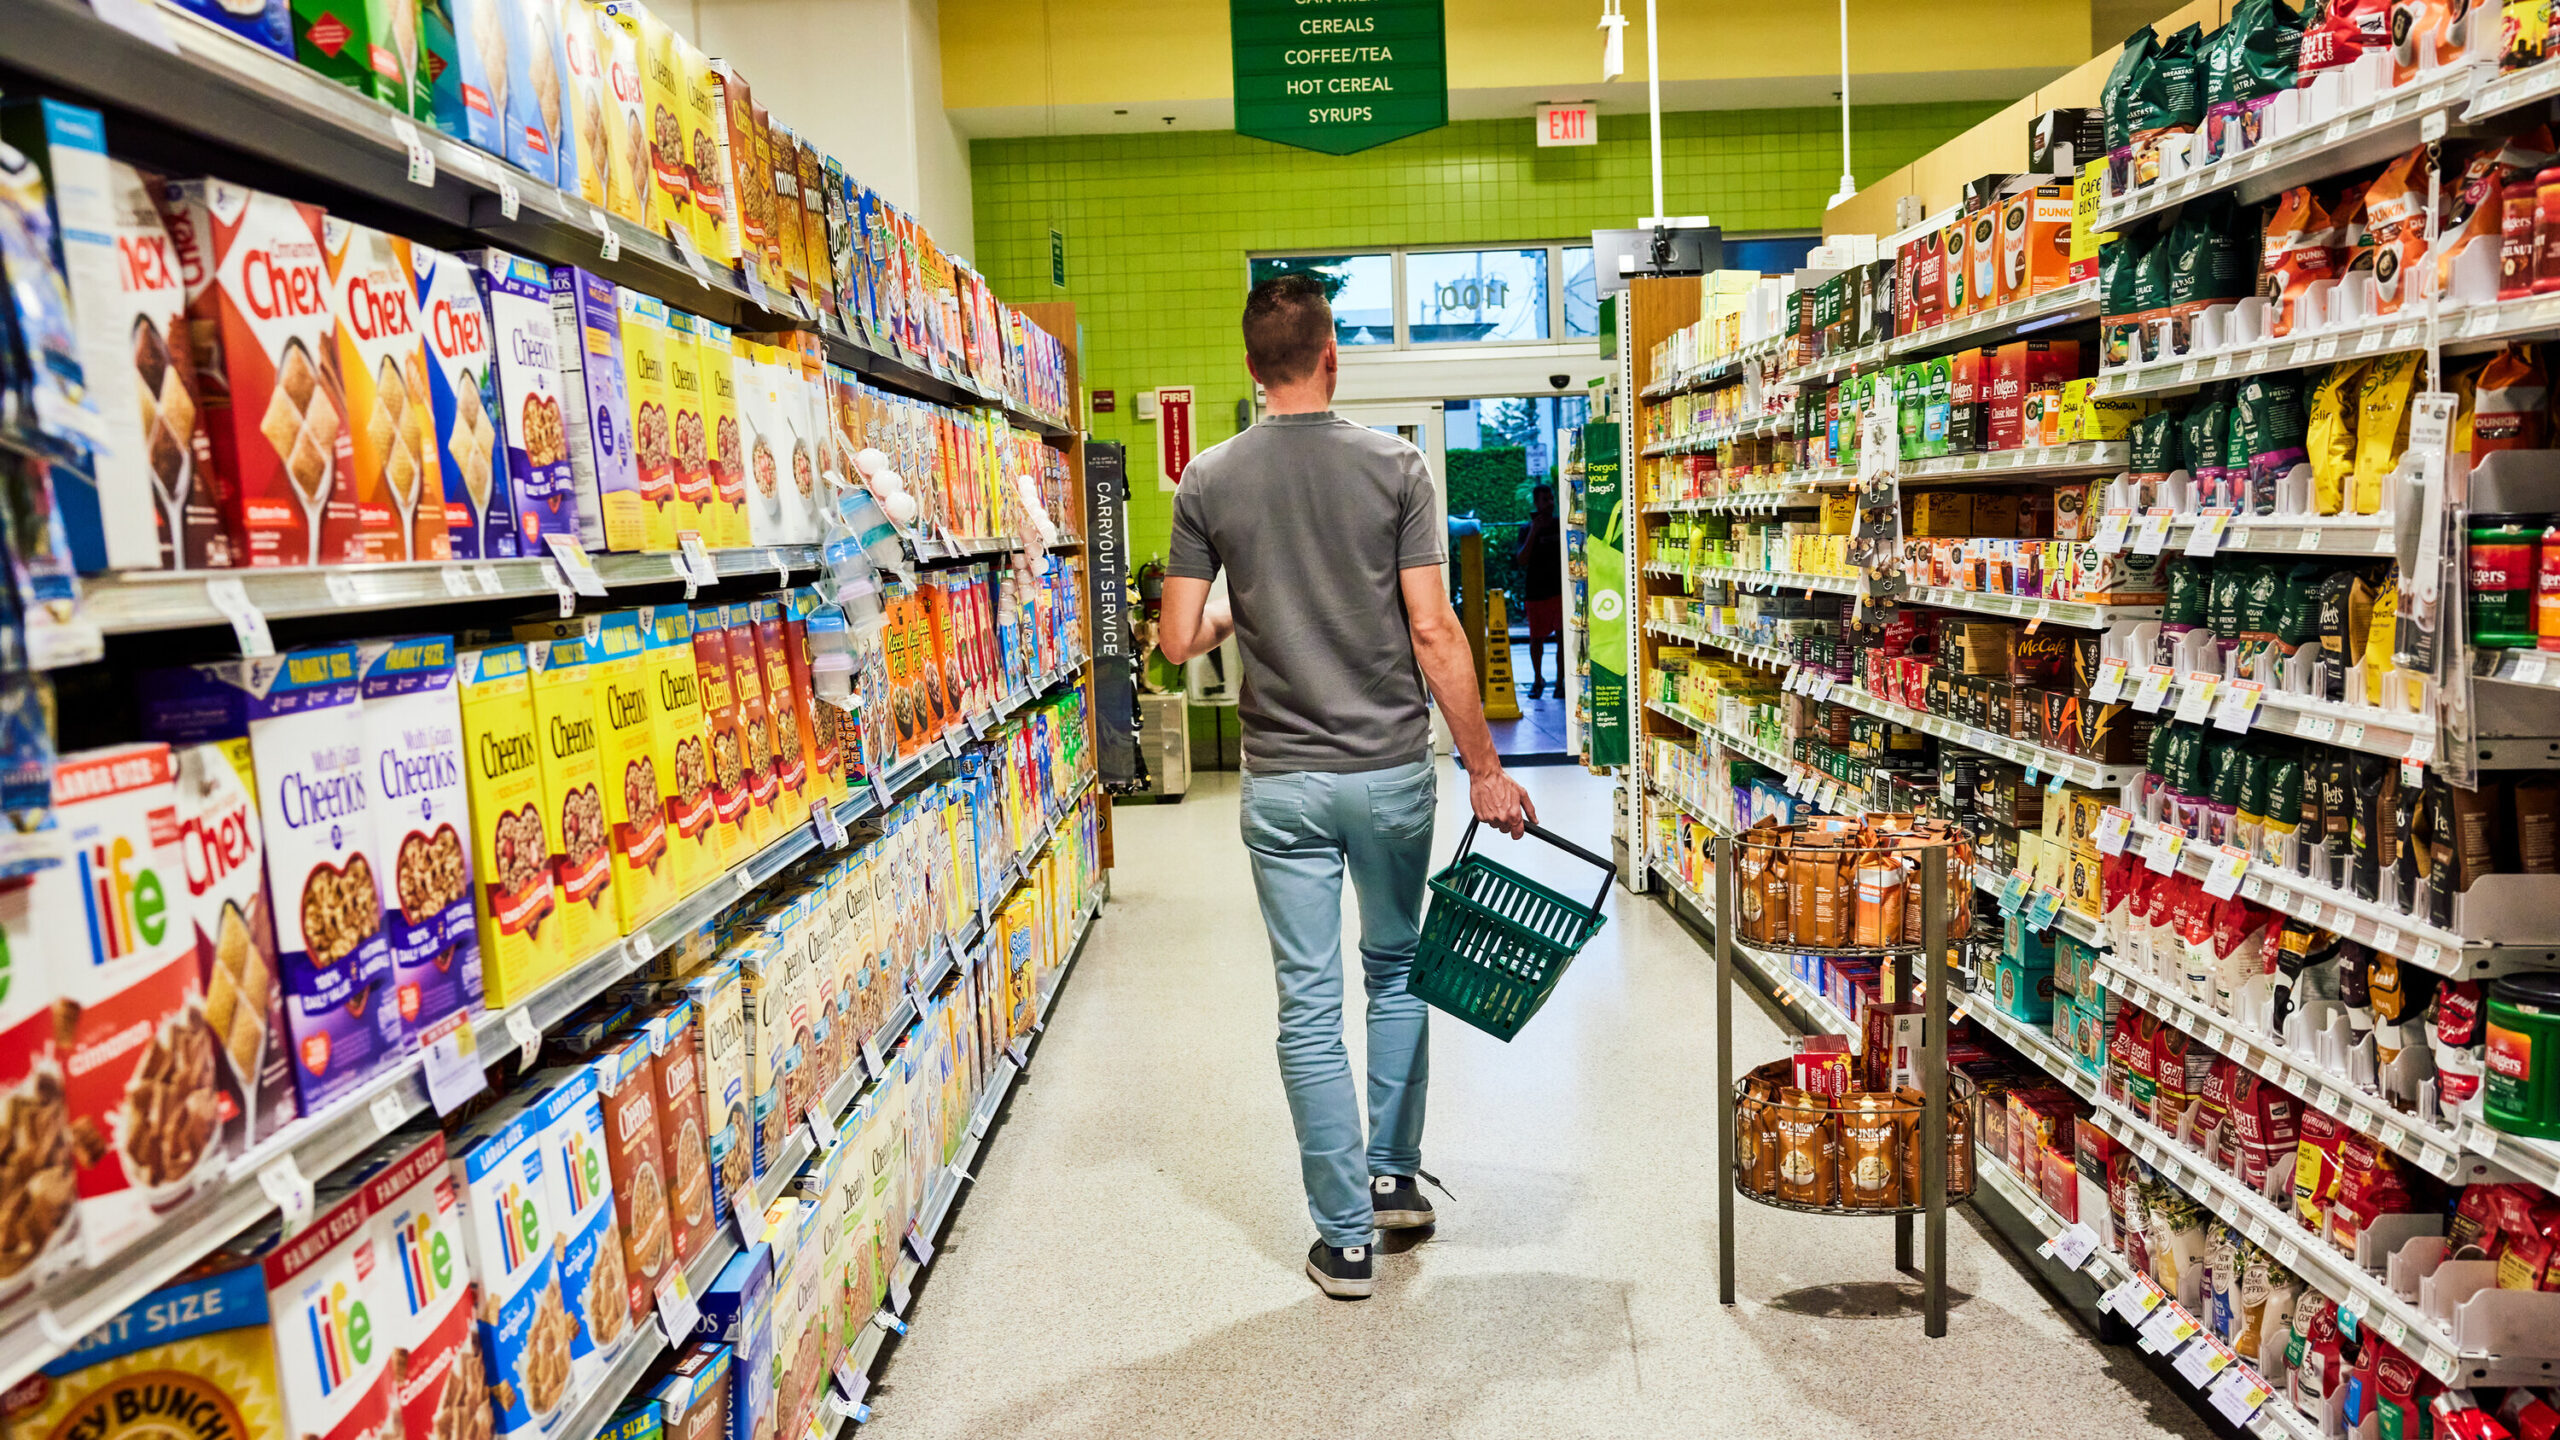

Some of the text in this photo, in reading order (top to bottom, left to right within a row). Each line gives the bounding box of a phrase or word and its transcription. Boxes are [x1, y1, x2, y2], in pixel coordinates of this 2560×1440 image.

[1300, 17, 1375, 35] CEREALS
[1284, 47, 1393, 65] COFFEE/TEA
[2162, 68, 2195, 78] BREAKFAST
[611, 62, 645, 104] Chex
[1287, 77, 1393, 94] HOT CEREAL
[1309, 107, 1372, 123] SYRUPS
[1549, 110, 1587, 140] EXIT
[2038, 188, 2059, 196] KEURIG
[2078, 197, 2101, 216] BUSTE
[2038, 206, 2073, 217] DUNKI
[1920, 255, 1940, 275] EIGHT
[243, 249, 327, 320] Chex
[348, 276, 414, 341] Chex
[433, 299, 487, 358] Chex
[636, 349, 663, 381] Cheerios
[672, 361, 698, 392] Cheerios
[1161, 392, 1189, 403] FIRE
[1952, 382, 1973, 403] Folgers
[1993, 378, 2018, 402] Folgers
[2093, 400, 2137, 410] COLOMBIA
[1991, 405, 2018, 420] Classic Roast
[1172, 407, 1181, 473] EXTINGUISHER
[1588, 463, 1618, 474] Forgot
[1588, 473, 1609, 484] your
[1588, 483, 1615, 494] bags?
[1097, 482, 1115, 575] CARRYOUT
[2470, 567, 2507, 587] lgers
[2246, 608, 2264, 617] HOUSE
[2479, 593, 2508, 604] Decaf
[1101, 580, 1118, 655] SERVICE
[1886, 626, 1913, 637] Hortons
[2219, 616, 2237, 624] FRENCH
[660, 669, 698, 712] Cheerios
[701, 677, 732, 711] Cheerios
[736, 669, 762, 701] Cheerios
[607, 685, 649, 731] Cheerios
[550, 715, 596, 760] Cheerios
[480, 731, 536, 780] Cheerios
[379, 747, 458, 801] Cheerios
[280, 770, 367, 831] Cheerios
[180, 804, 255, 897] Chex
[78, 836, 167, 966] life
[845, 883, 871, 920] Cheerios
[710, 1005, 743, 1062] Cheerios
[666, 1053, 694, 1099] Cheerios
[2486, 1045, 2522, 1073] Folgers
[547, 1079, 589, 1120] LARGE SIZE
[618, 1094, 652, 1143] Cheerios
[2302, 1113, 2333, 1135] mmunity
[478, 1124, 526, 1174] LARGE SIZE
[375, 1147, 439, 1206] FAMILY SIZE
[562, 1131, 601, 1217] life
[283, 1207, 359, 1275] FAMILY SIZE
[496, 1182, 540, 1276] life
[396, 1213, 453, 1316] life
[564, 1238, 593, 1279] original
[145, 1288, 224, 1333] SIZE
[499, 1297, 532, 1343] original
[308, 1281, 373, 1399] life
[693, 1372, 716, 1398] LARGE
[112, 1384, 231, 1440] BUNCH
[622, 1413, 652, 1440] SIZE
